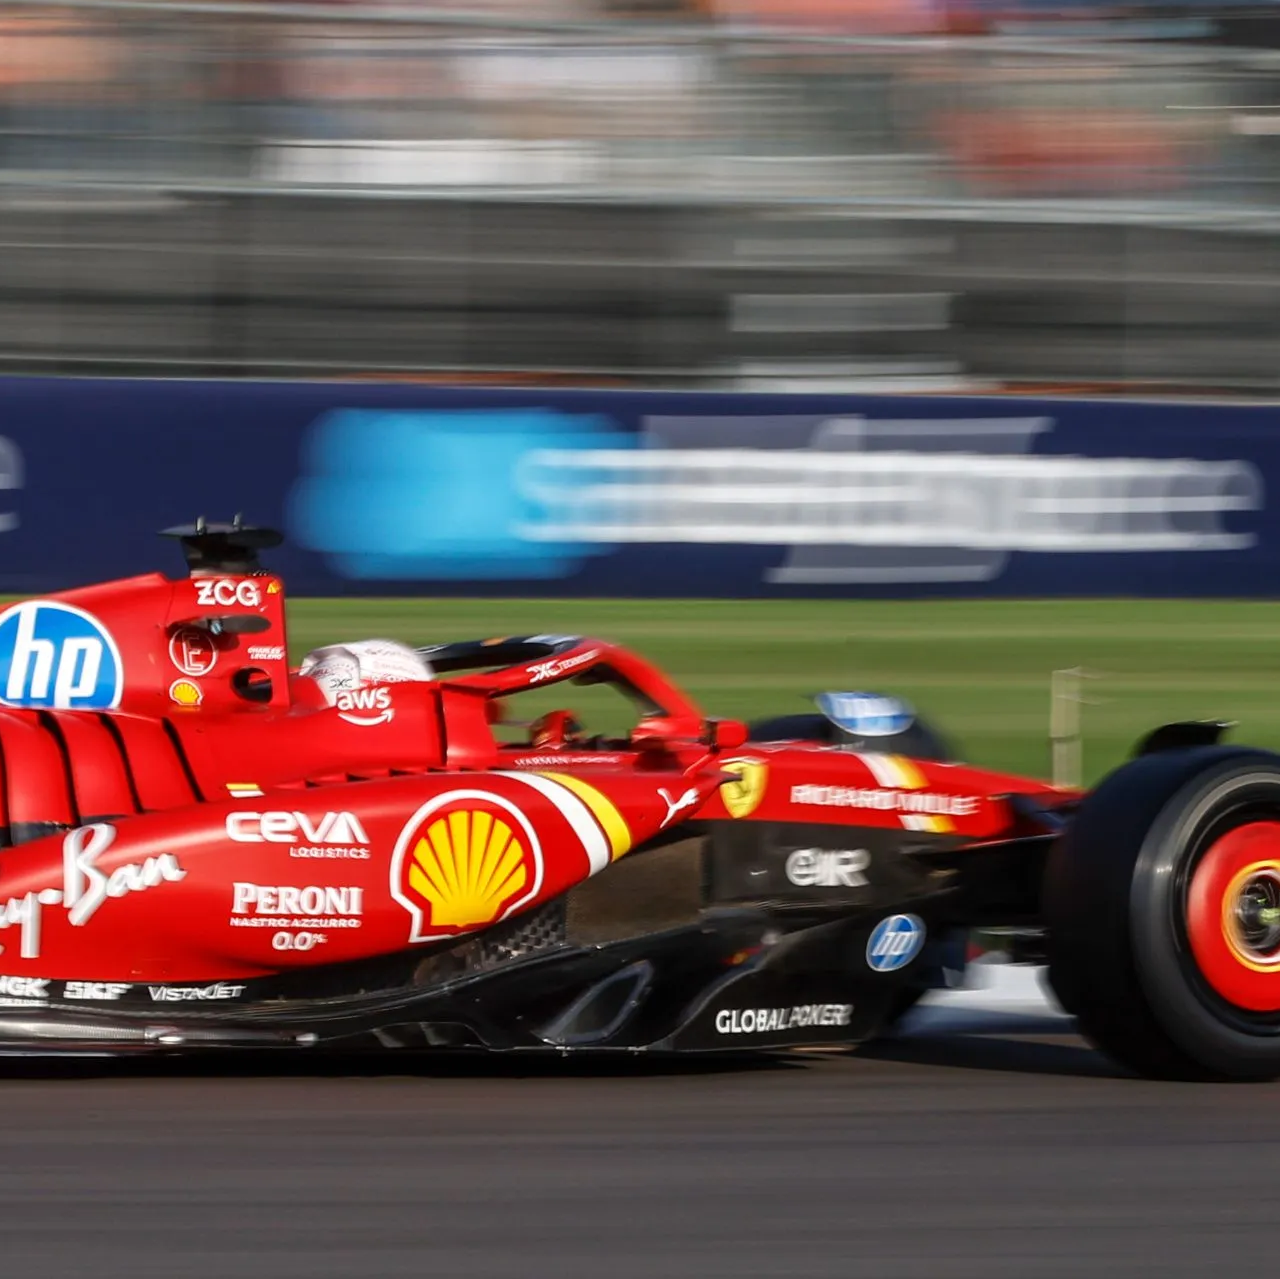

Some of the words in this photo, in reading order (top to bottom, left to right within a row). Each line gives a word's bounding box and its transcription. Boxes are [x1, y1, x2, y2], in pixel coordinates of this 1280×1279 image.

[194, 580, 261, 606] ZCG
[7, 603, 104, 709] hp
[336, 687, 392, 711] aws
[290, 847, 370, 859] LOGISTICS
[232, 882, 363, 915] PERONI
[230, 917, 290, 927] NASTRO
[291, 918, 362, 929] AZZURRO
[63, 981, 134, 1000] SKF
[715, 1007, 790, 1033] GLOBAL
[788, 1004, 854, 1028] POKER
